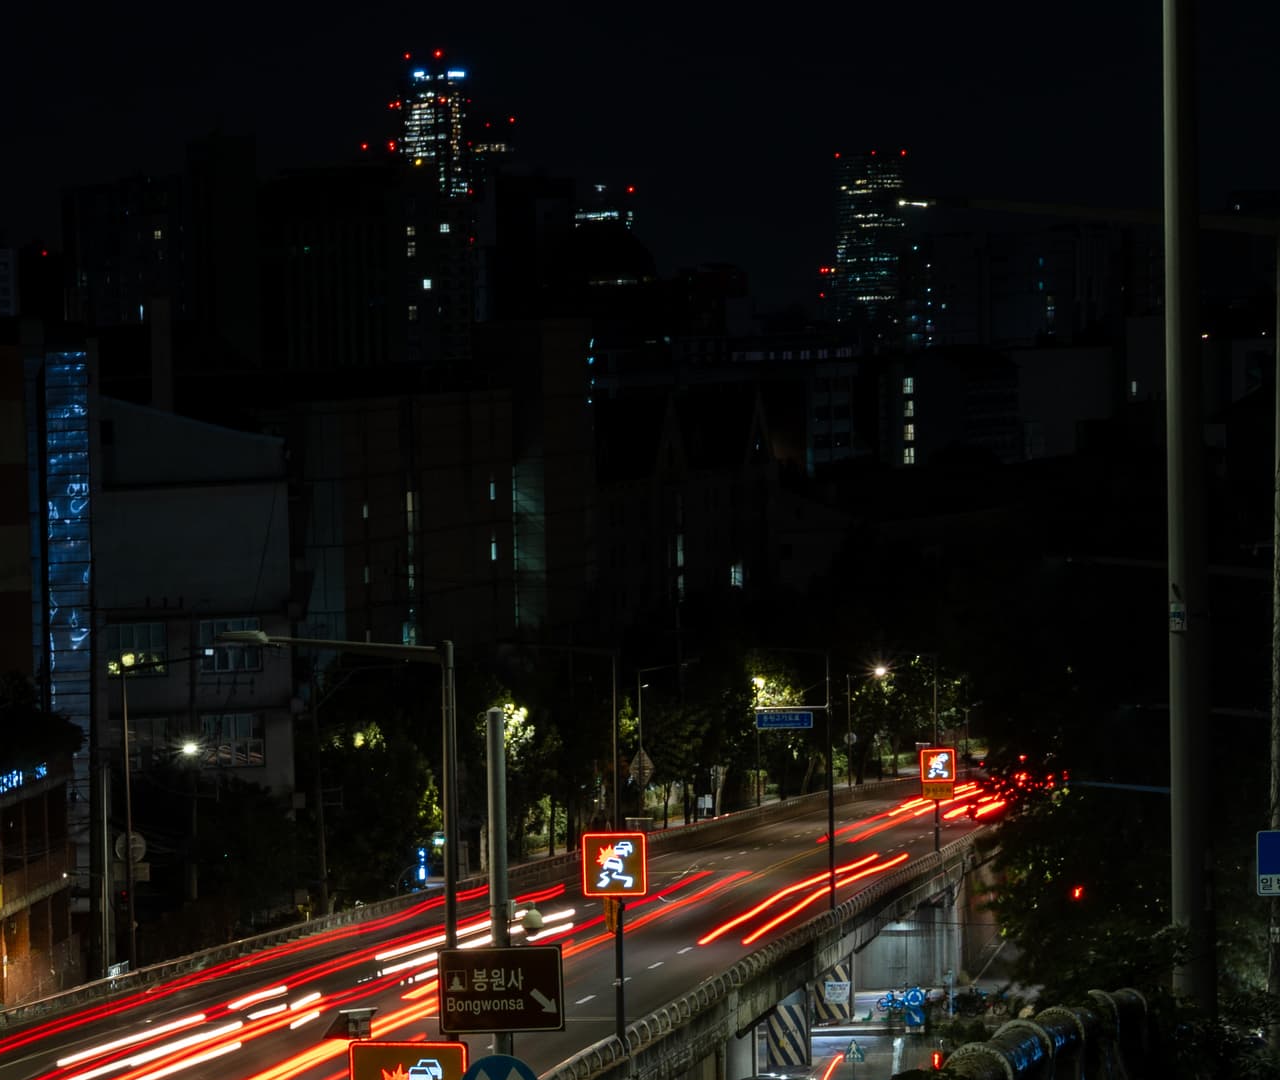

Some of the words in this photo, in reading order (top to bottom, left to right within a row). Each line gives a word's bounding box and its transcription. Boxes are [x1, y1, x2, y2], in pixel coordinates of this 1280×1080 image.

[1260, 876, 1280, 891] 일
[471, 967, 525, 992] 봉원사
[446, 996, 525, 1015] Bongwonsa
